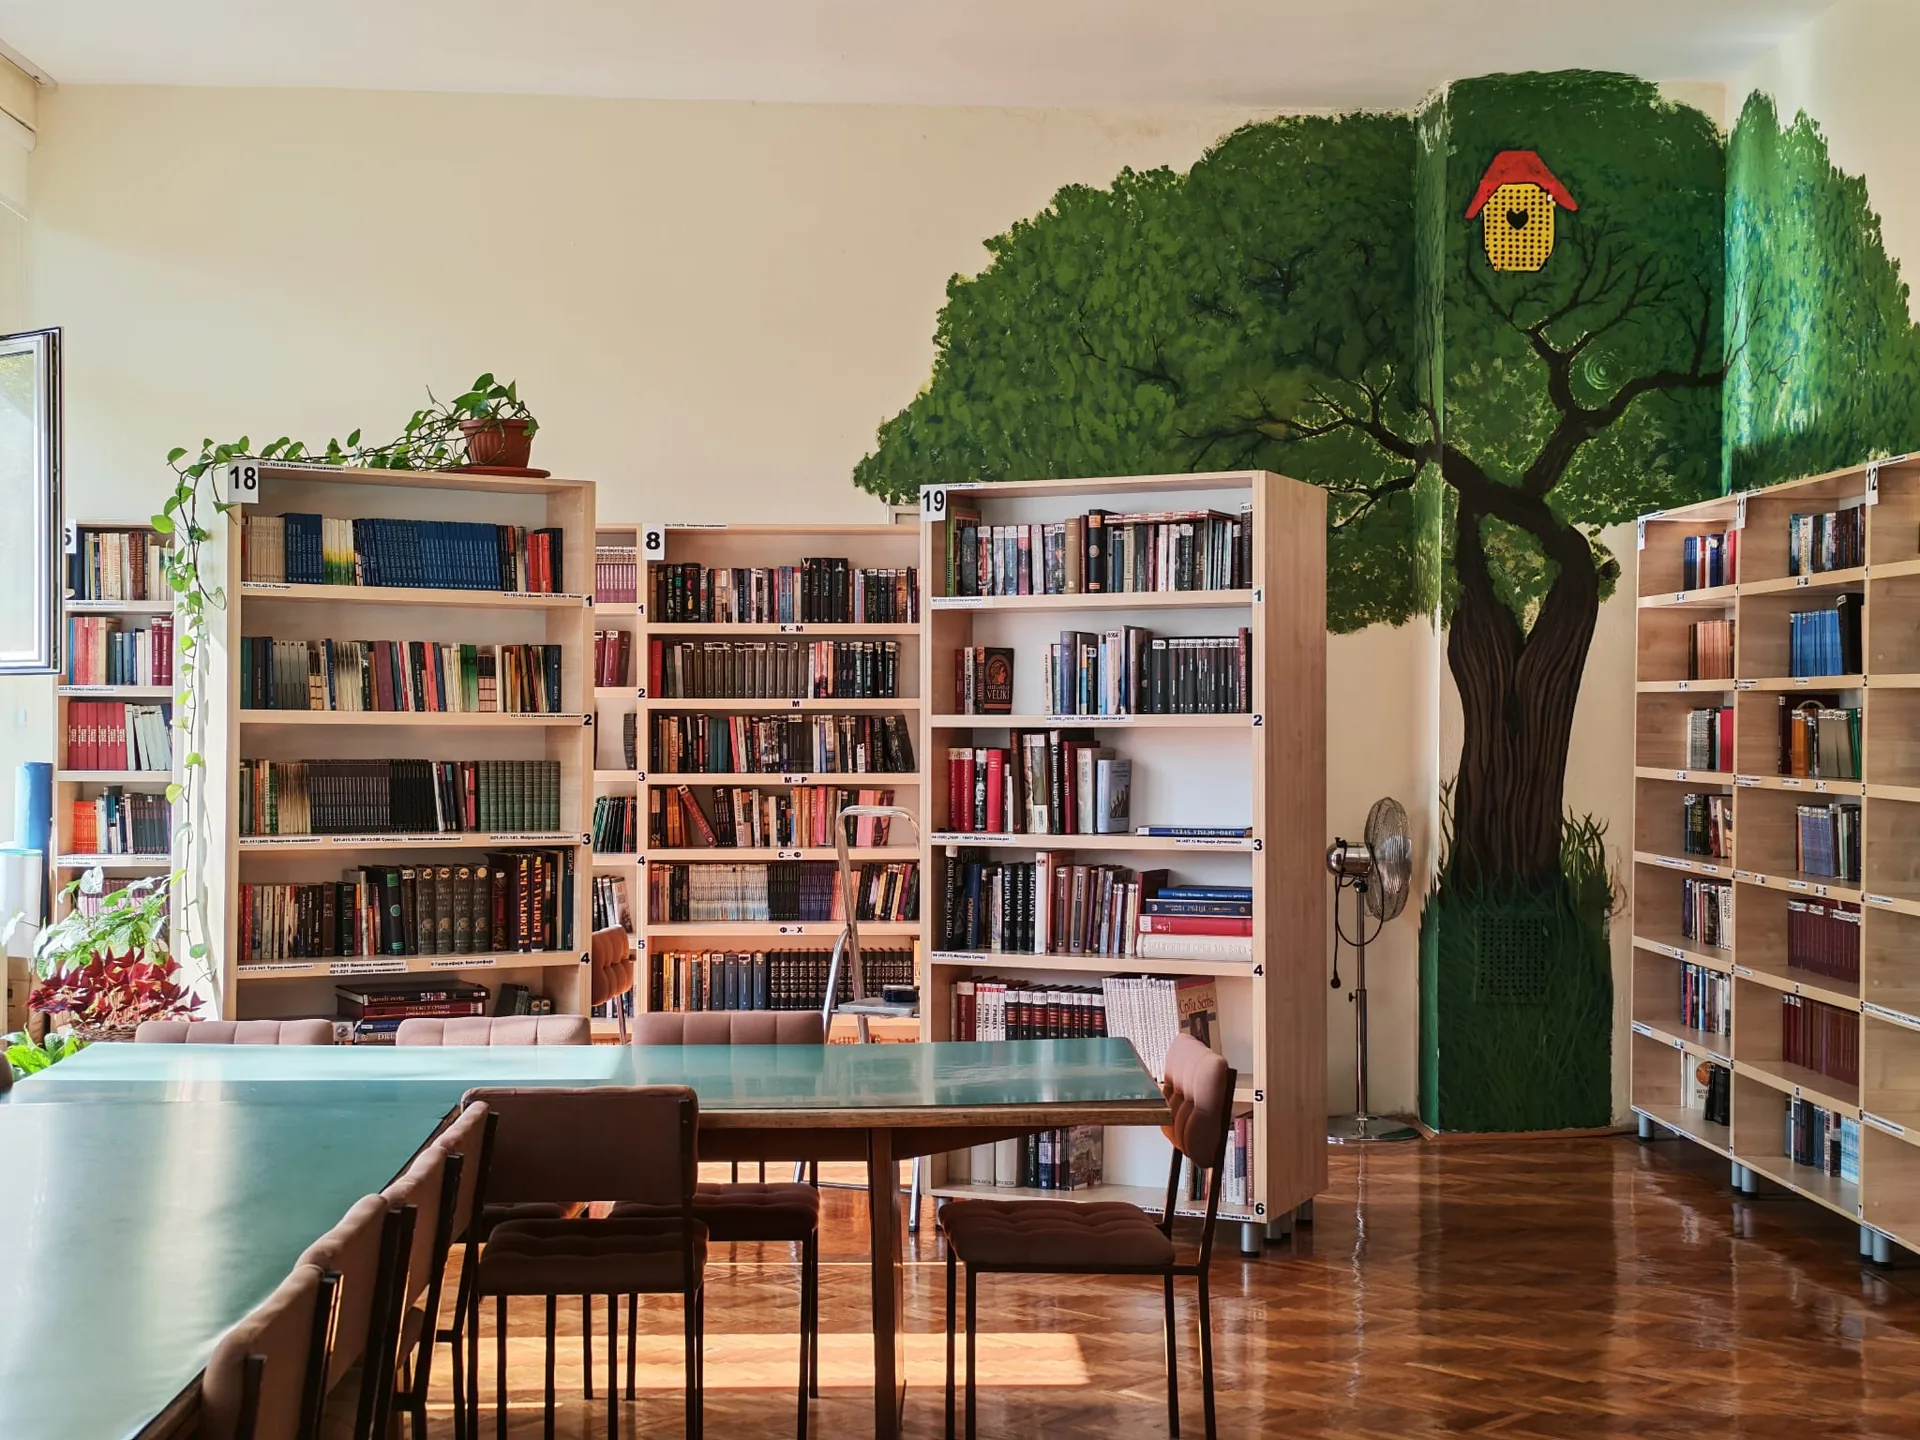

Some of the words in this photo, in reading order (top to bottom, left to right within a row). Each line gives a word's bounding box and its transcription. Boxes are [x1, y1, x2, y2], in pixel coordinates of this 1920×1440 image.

[230, 466, 257, 490] 18
[1867, 470, 1877, 490] 12
[922, 490, 944, 512] 19
[1738, 498, 1746, 519] 11
[646, 531, 660, 550] 8
[586, 595, 593, 607] 1
[1254, 590, 1263, 602] 1
[638, 604, 645, 614] 1
[1864, 674, 1868, 686] 2
[638, 688, 645, 698] 2
[987, 690, 1010, 700] VELIKI
[792, 700, 800, 708] М
[583, 714, 592, 726] 2
[1253, 714, 1263, 726] 2
[638, 772, 645, 782] 3
[582, 833, 591, 845] 3
[1254, 839, 1262, 851] 3
[637, 855, 646, 866] 4
[638, 940, 645, 950] 5
[580, 952, 590, 964] 4
[1253, 965, 1264, 977] 4
[1197, 992, 1214, 1010] Serbs
[1860, 1000, 1864, 1013] 5
[1254, 1090, 1264, 1101] 5
[1255, 1203, 1264, 1215] 6
